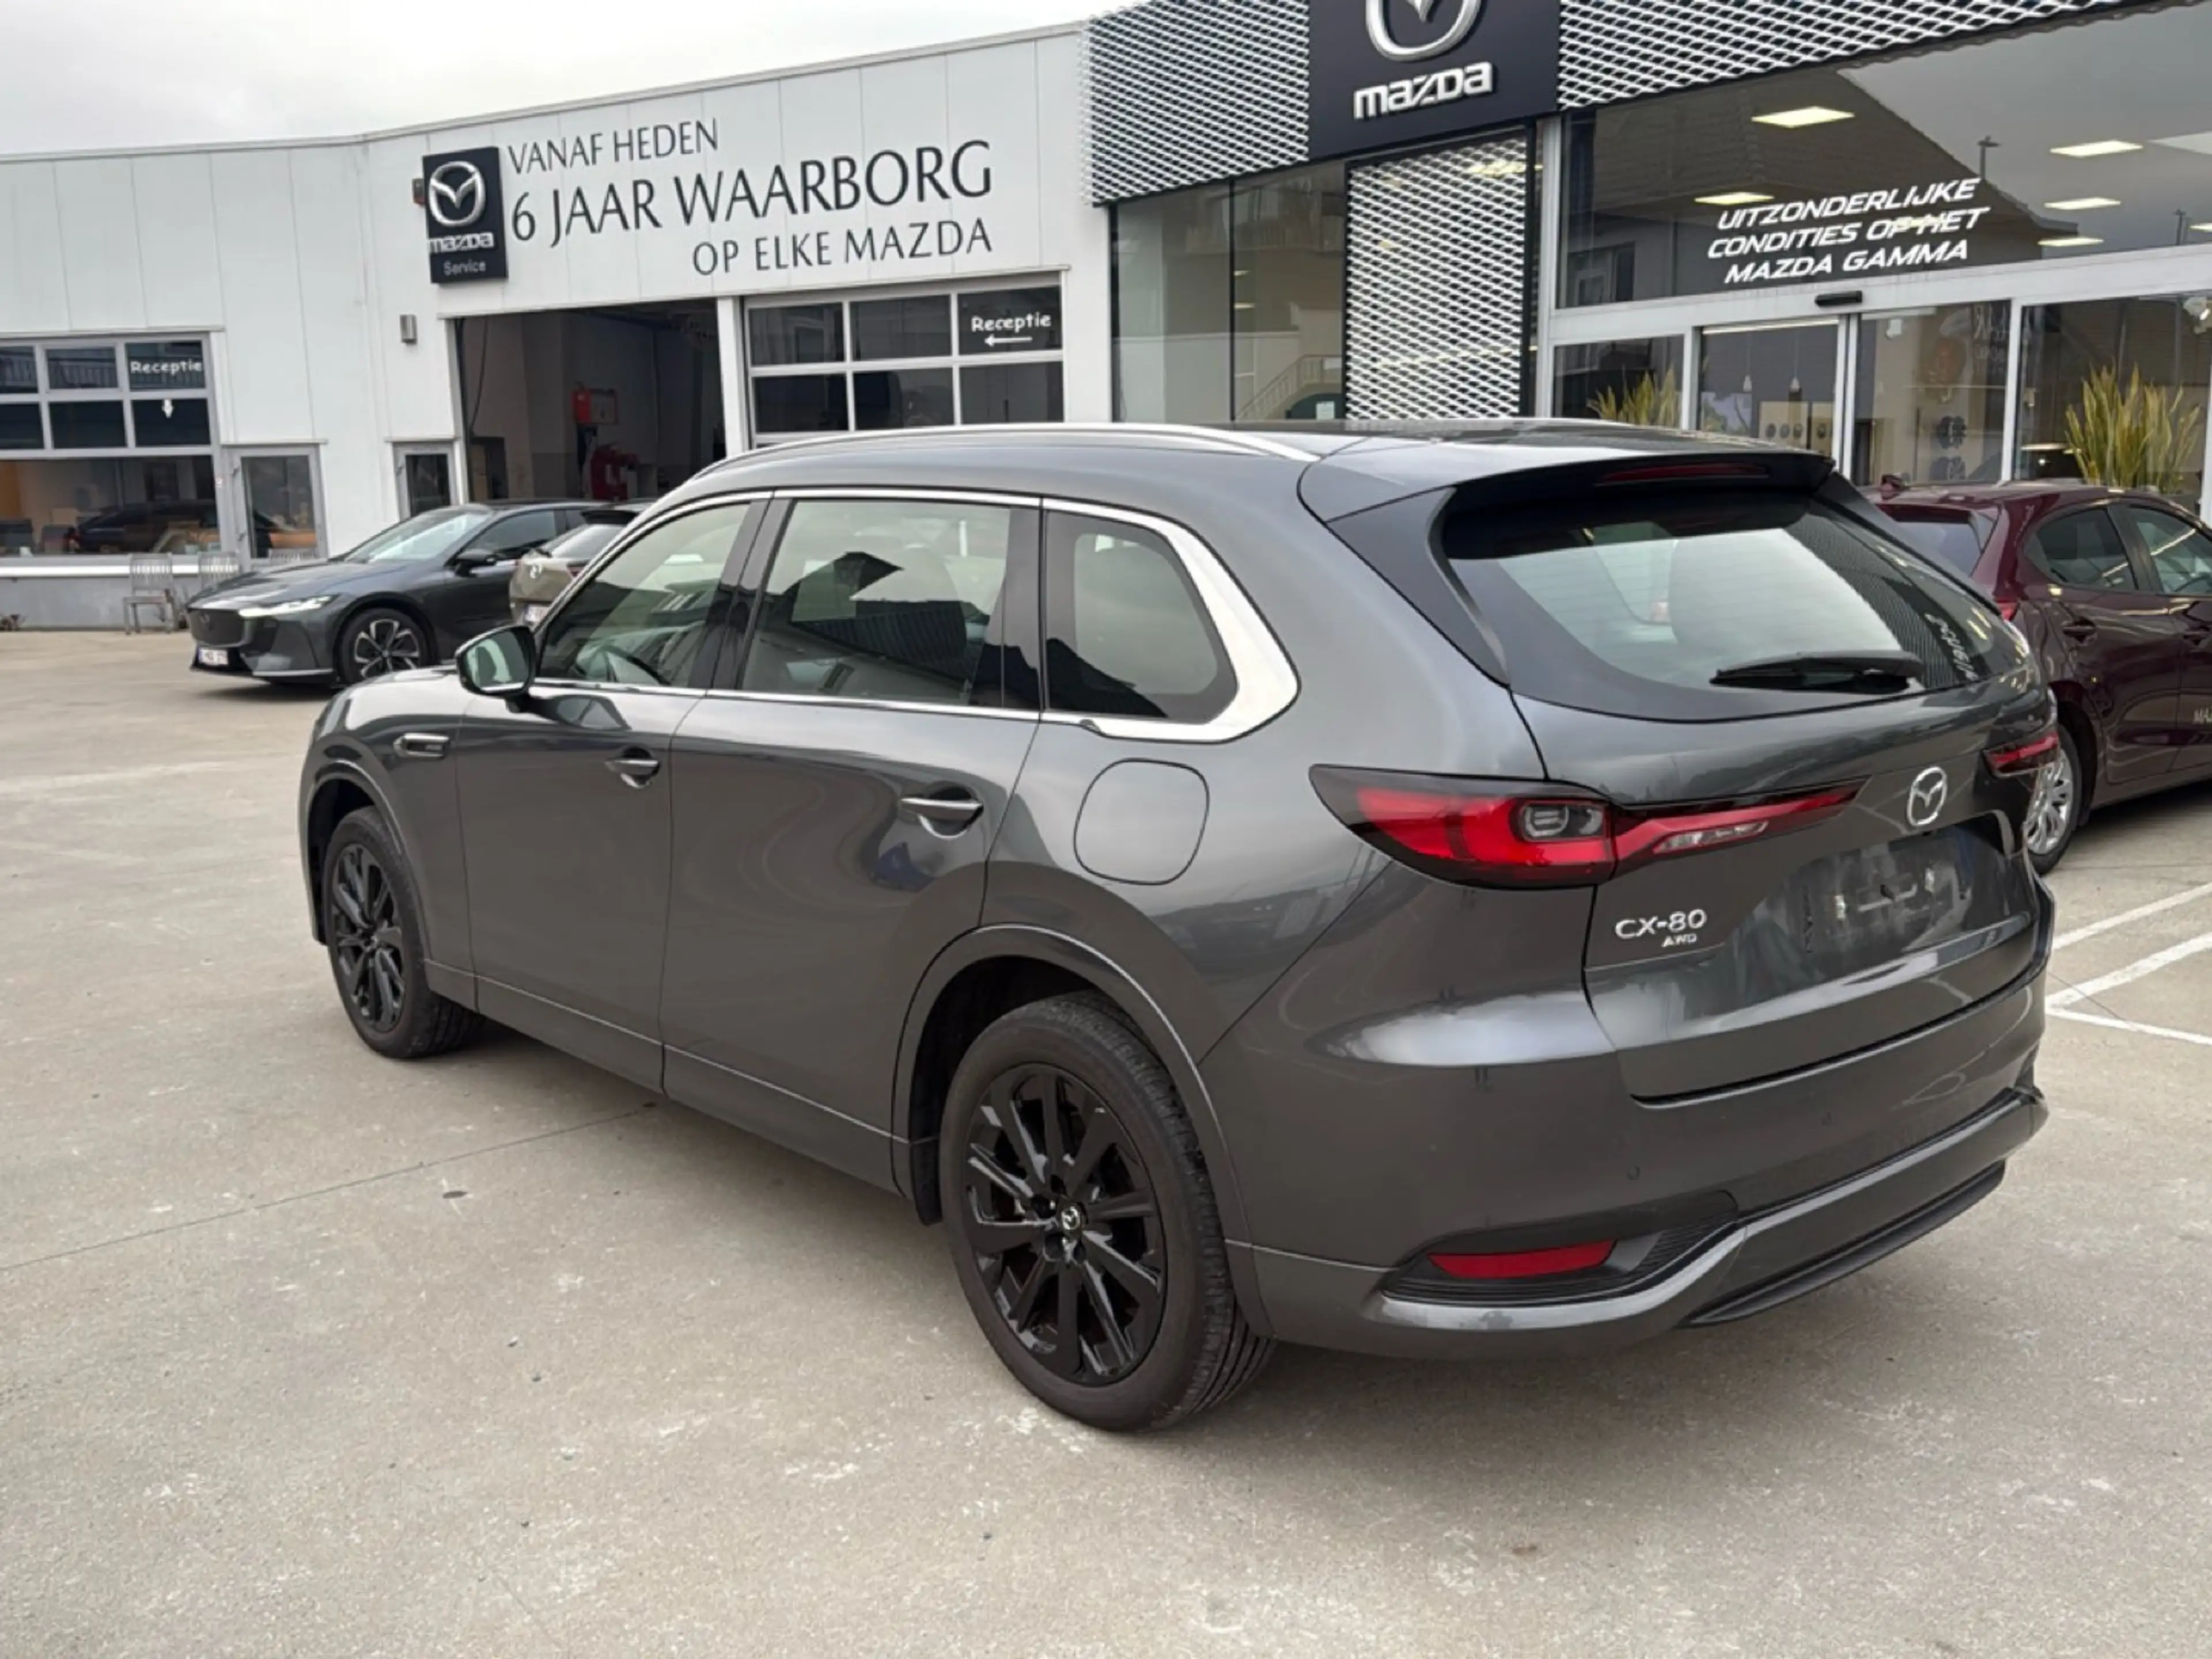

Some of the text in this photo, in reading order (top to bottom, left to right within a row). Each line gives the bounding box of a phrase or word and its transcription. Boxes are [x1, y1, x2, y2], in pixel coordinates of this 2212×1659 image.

[1354, 61, 1493, 119] mazda
[508, 118, 718, 174] VANAF HEDEN
[512, 139, 991, 248] 6 JAAR WAARBORG
[1717, 177, 1980, 230] UITZONDERLIJKE
[692, 217, 993, 276] OP ELKE MAZDA
[1707, 207, 1991, 259] CONDITIES OP HET
[443, 259, 486, 276] Service
[1724, 239, 1968, 284] MAZDA GAMMA
[971, 311, 1052, 334] Receptie
[130, 352, 203, 376] Receptie
[1615, 908, 1707, 940] CX-80
[1661, 933, 1697, 948] AWD
